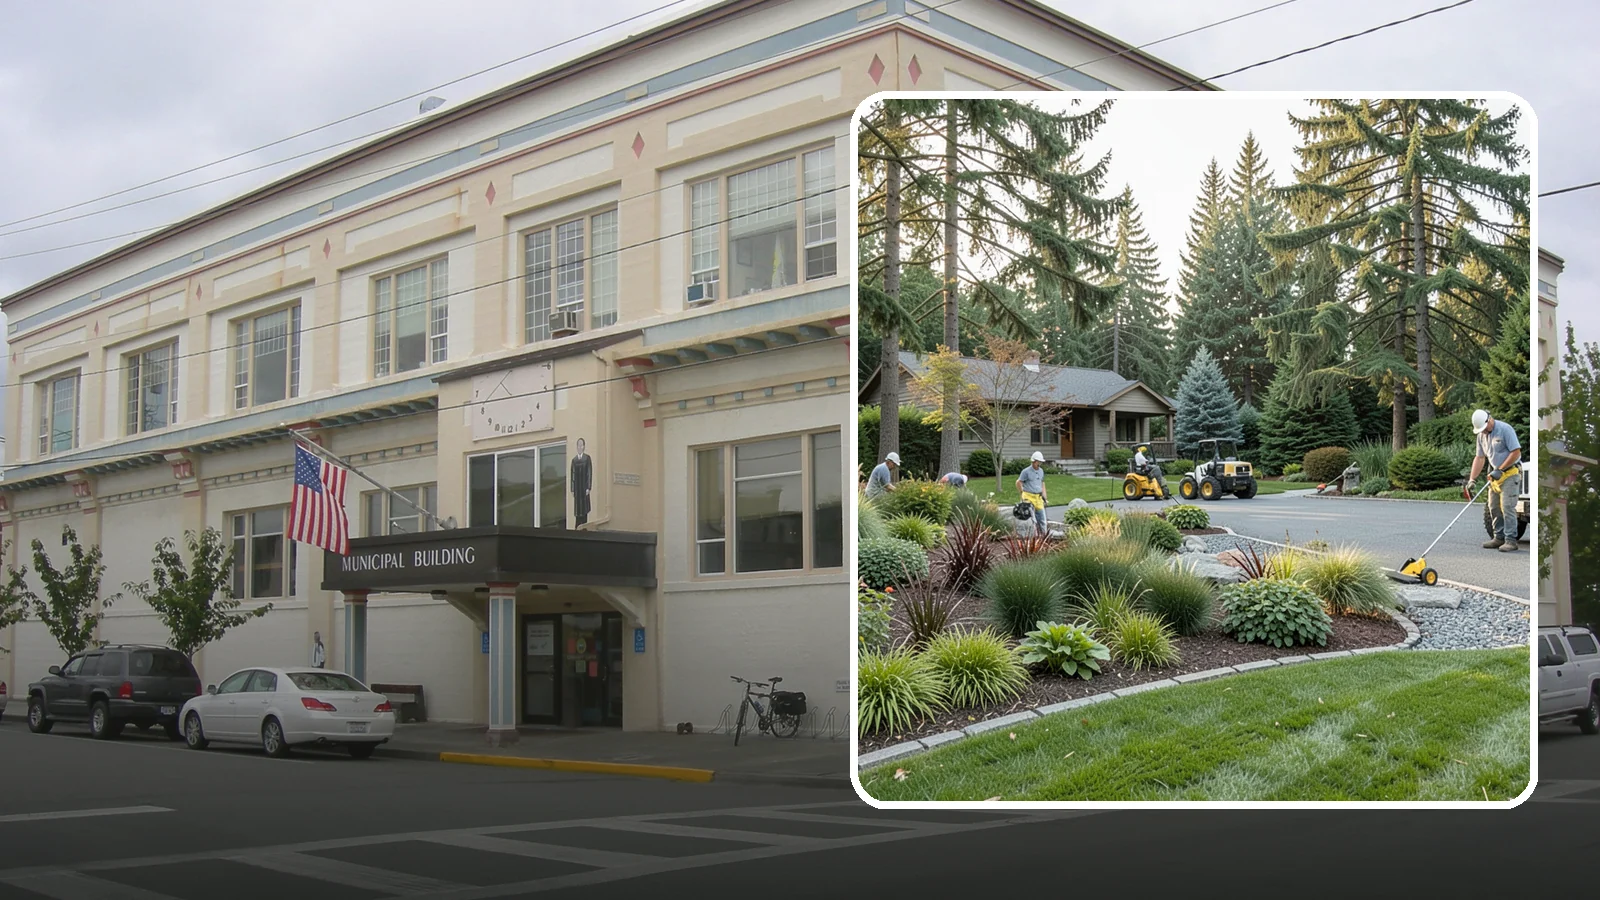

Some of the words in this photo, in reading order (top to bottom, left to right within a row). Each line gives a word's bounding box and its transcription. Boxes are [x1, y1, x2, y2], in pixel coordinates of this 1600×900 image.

[475, 390, 479, 398] 7
[535, 402, 540, 410] 4
[480, 407, 485, 415] 8
[487, 417, 492, 426] 9
[529, 414, 533, 422] 3
[494, 423, 500, 432] 10
[521, 420, 525, 428] 2
[502, 425, 506, 434] 11
[507, 425, 513, 433] 12
[342, 552, 405, 571] MUNICIPAL
[414, 546, 475, 567] BUILDING
